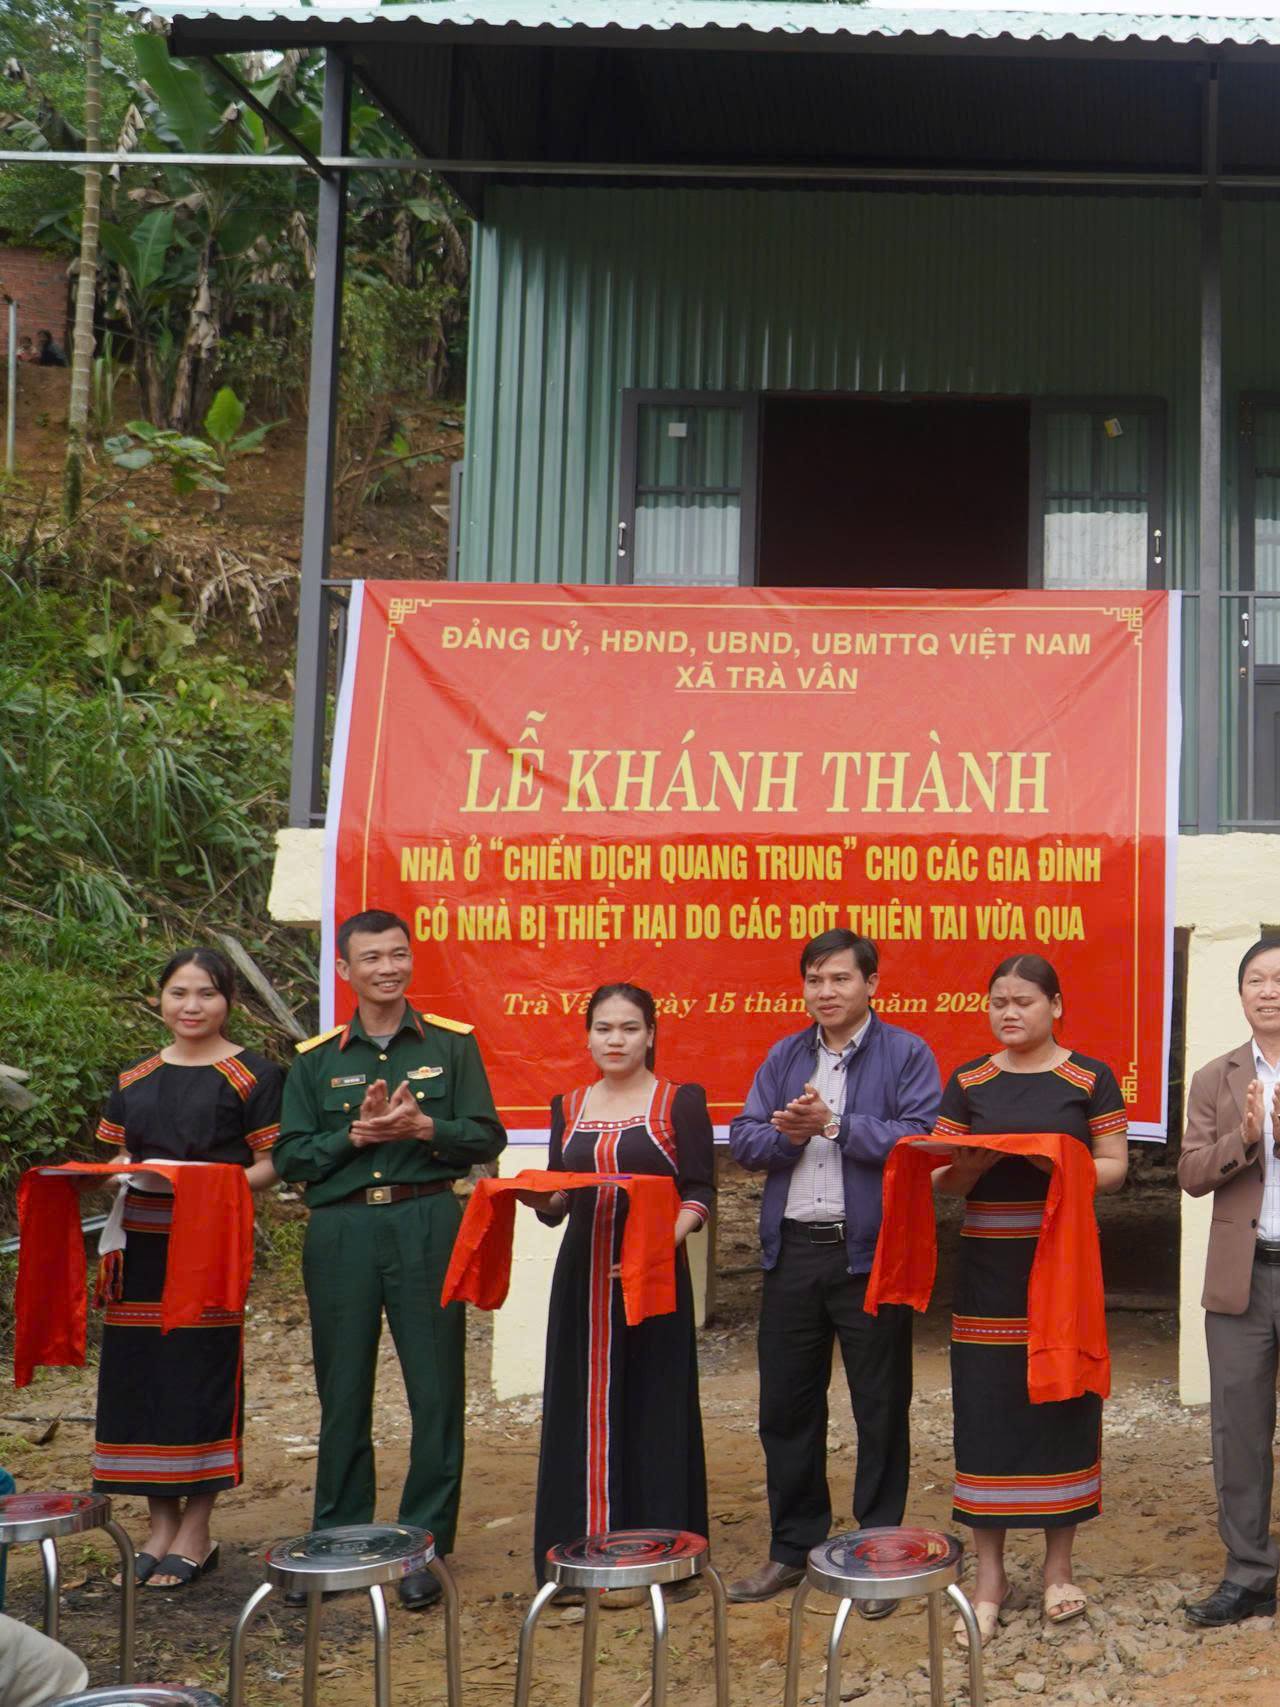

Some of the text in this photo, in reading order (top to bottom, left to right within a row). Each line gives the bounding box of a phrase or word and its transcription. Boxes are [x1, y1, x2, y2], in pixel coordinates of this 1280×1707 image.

[441, 618, 530, 650] ĐẢNG
[600, 629, 696, 657] HĐND,
[707, 631, 801, 658] UBND,
[811, 632, 940, 656] UBMTTQ
[949, 626, 1016, 660] VIỆT
[1025, 632, 1091, 655] NAM
[675, 660, 858, 690] XÃ TRÀ VÂN
[460, 710, 1051, 814] LỄ KHÁNH THÀNH
[400, 839, 455, 882] NHÀ
[463, 834, 482, 882] Ở
[590, 844, 652, 888] DỊCH
[659, 844, 748, 884] QUANG
[865, 845, 918, 881] CHO
[926, 839, 979, 882] CÁC
[986, 846, 1031, 882] GIA
[1037, 839, 1102, 883] ĐÌNH
[415, 898, 449, 942] CÓ
[457, 898, 512, 941] NHÀ
[519, 904, 546, 948] BỊ
[554, 896, 625, 948] THIỆT
[632, 904, 676, 947] HẠI
[685, 904, 721, 940] DO
[729, 897, 782, 940] CÁC
[846, 897, 922, 940] THIÊN
[929, 905, 968, 940] TAI
[975, 898, 1028, 941] VỪA
[1034, 905, 1086, 944] QUA
[503, 992, 550, 1016] Trà
[559, 991, 592, 1016] Vâ
[705, 992, 736, 1014] 15
[744, 991, 812, 1018] thán
[870, 992, 928, 1014] năm
